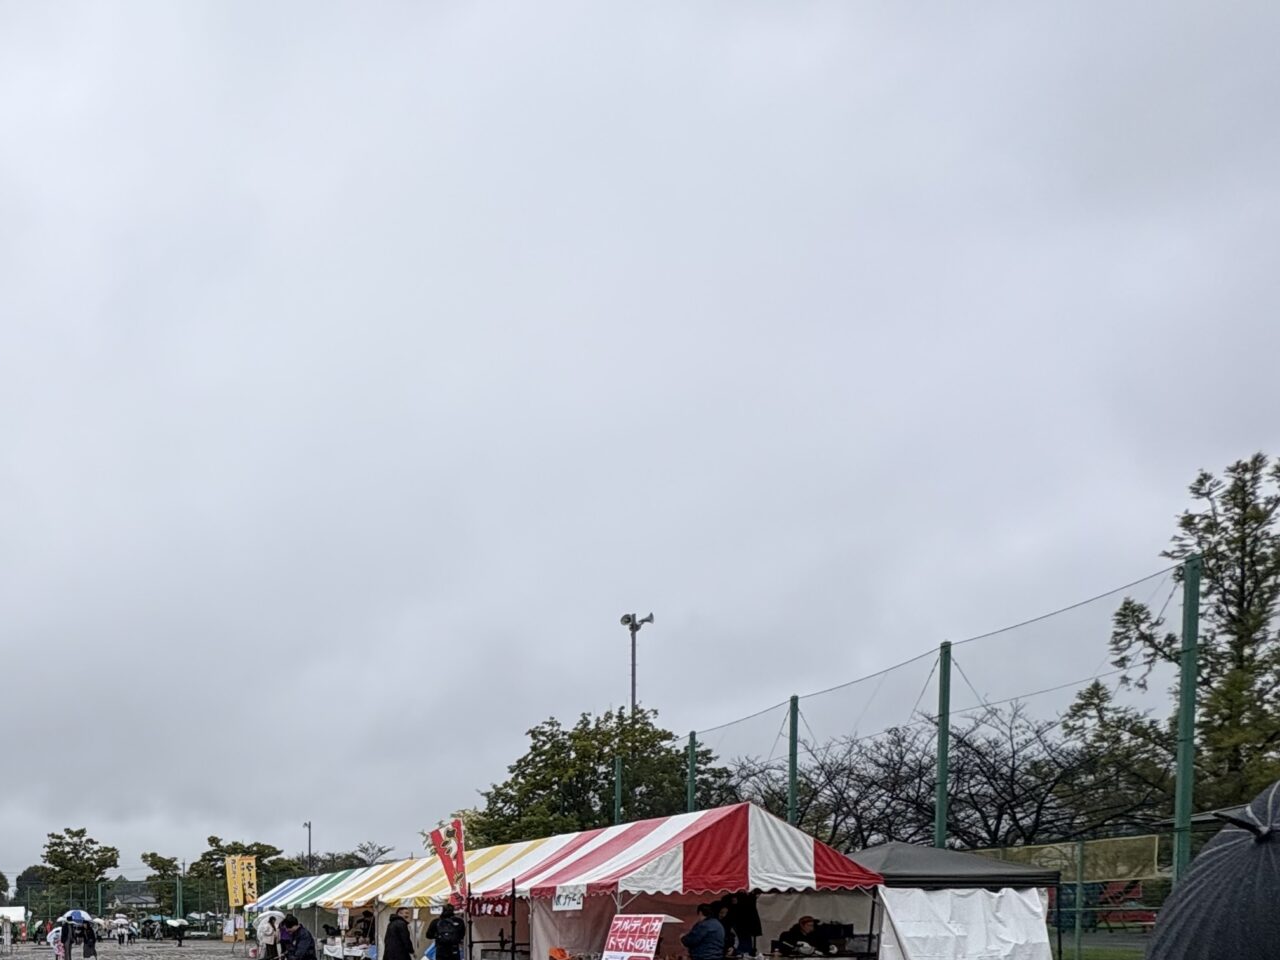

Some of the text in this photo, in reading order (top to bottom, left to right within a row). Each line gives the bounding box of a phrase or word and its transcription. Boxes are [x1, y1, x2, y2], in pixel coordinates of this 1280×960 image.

[611, 919, 662, 933] フルティカ
[607, 936, 657, 952] トマトの店
